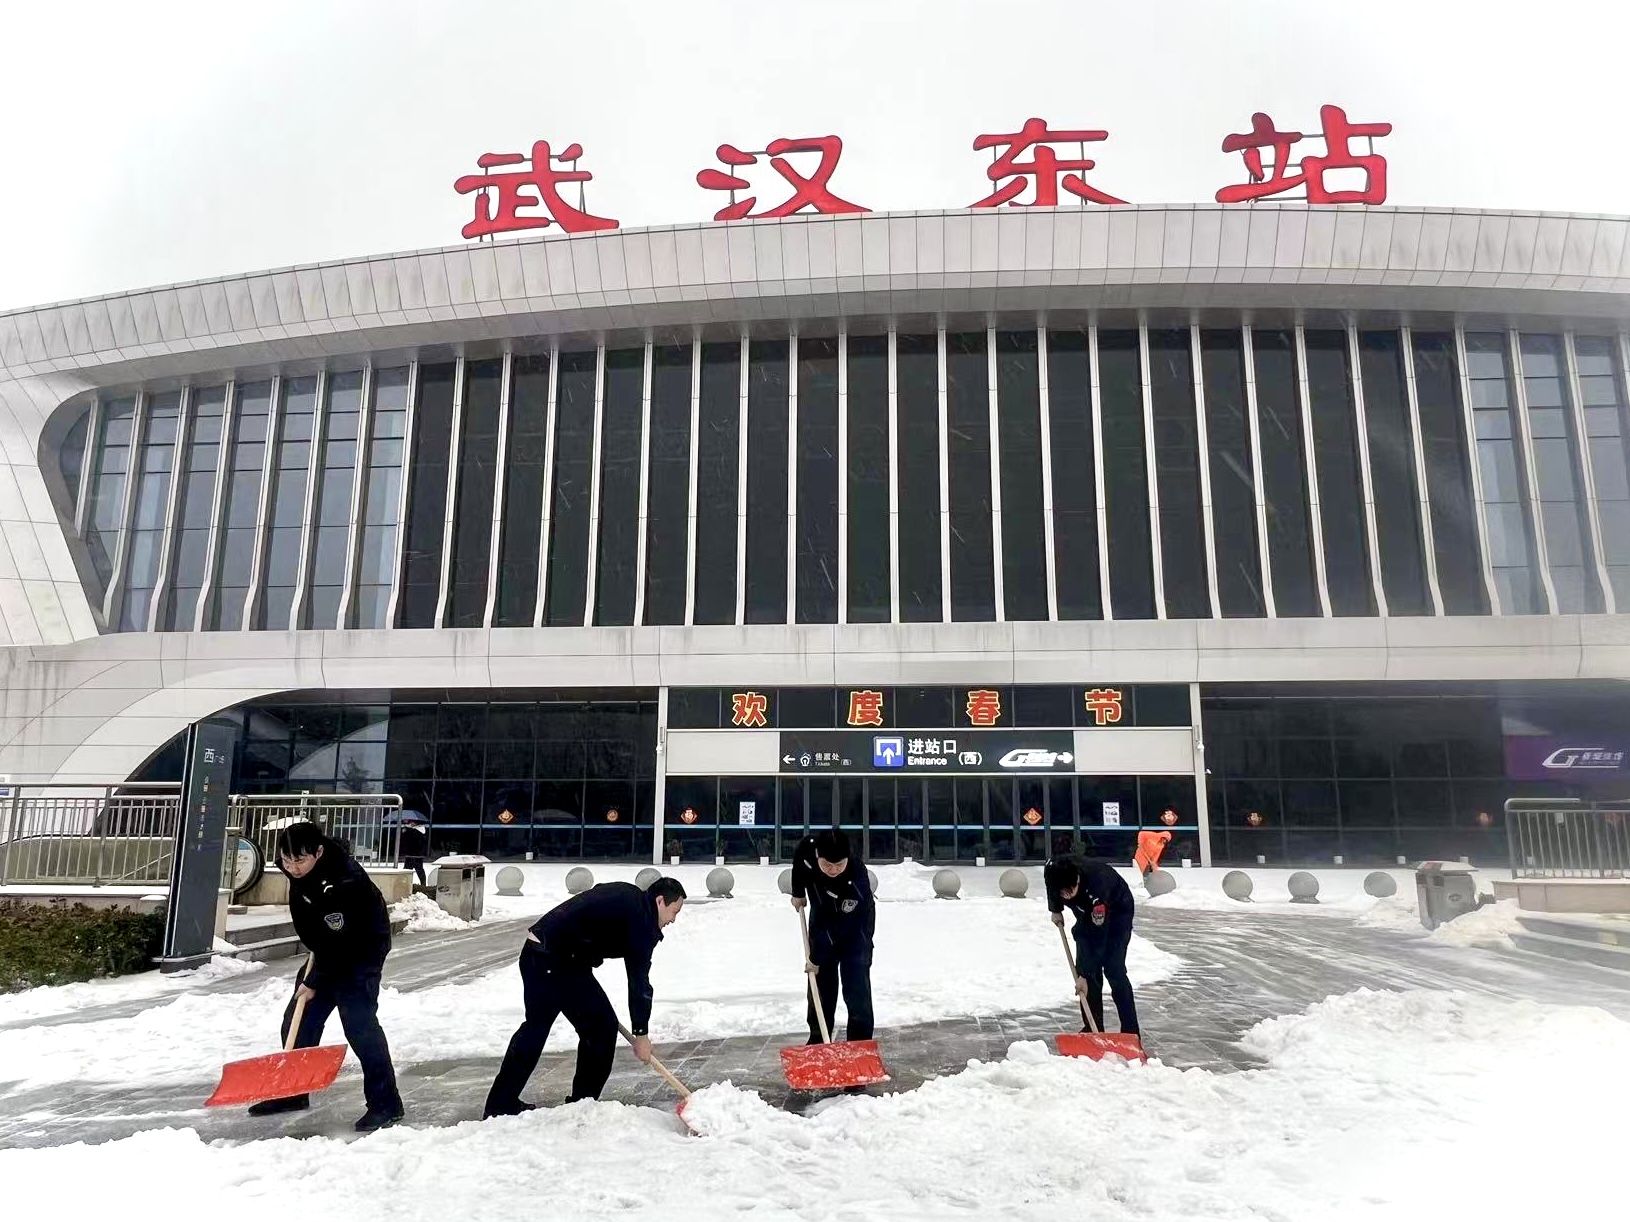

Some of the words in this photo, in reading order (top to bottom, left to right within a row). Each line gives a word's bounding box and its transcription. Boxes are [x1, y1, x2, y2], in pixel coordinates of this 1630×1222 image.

[454, 104, 1392, 239] 武汉东站
[732, 690, 1121, 727] 欢度春节
[908, 738, 957, 755] 进站口
[908, 756, 948, 766] Entrance
